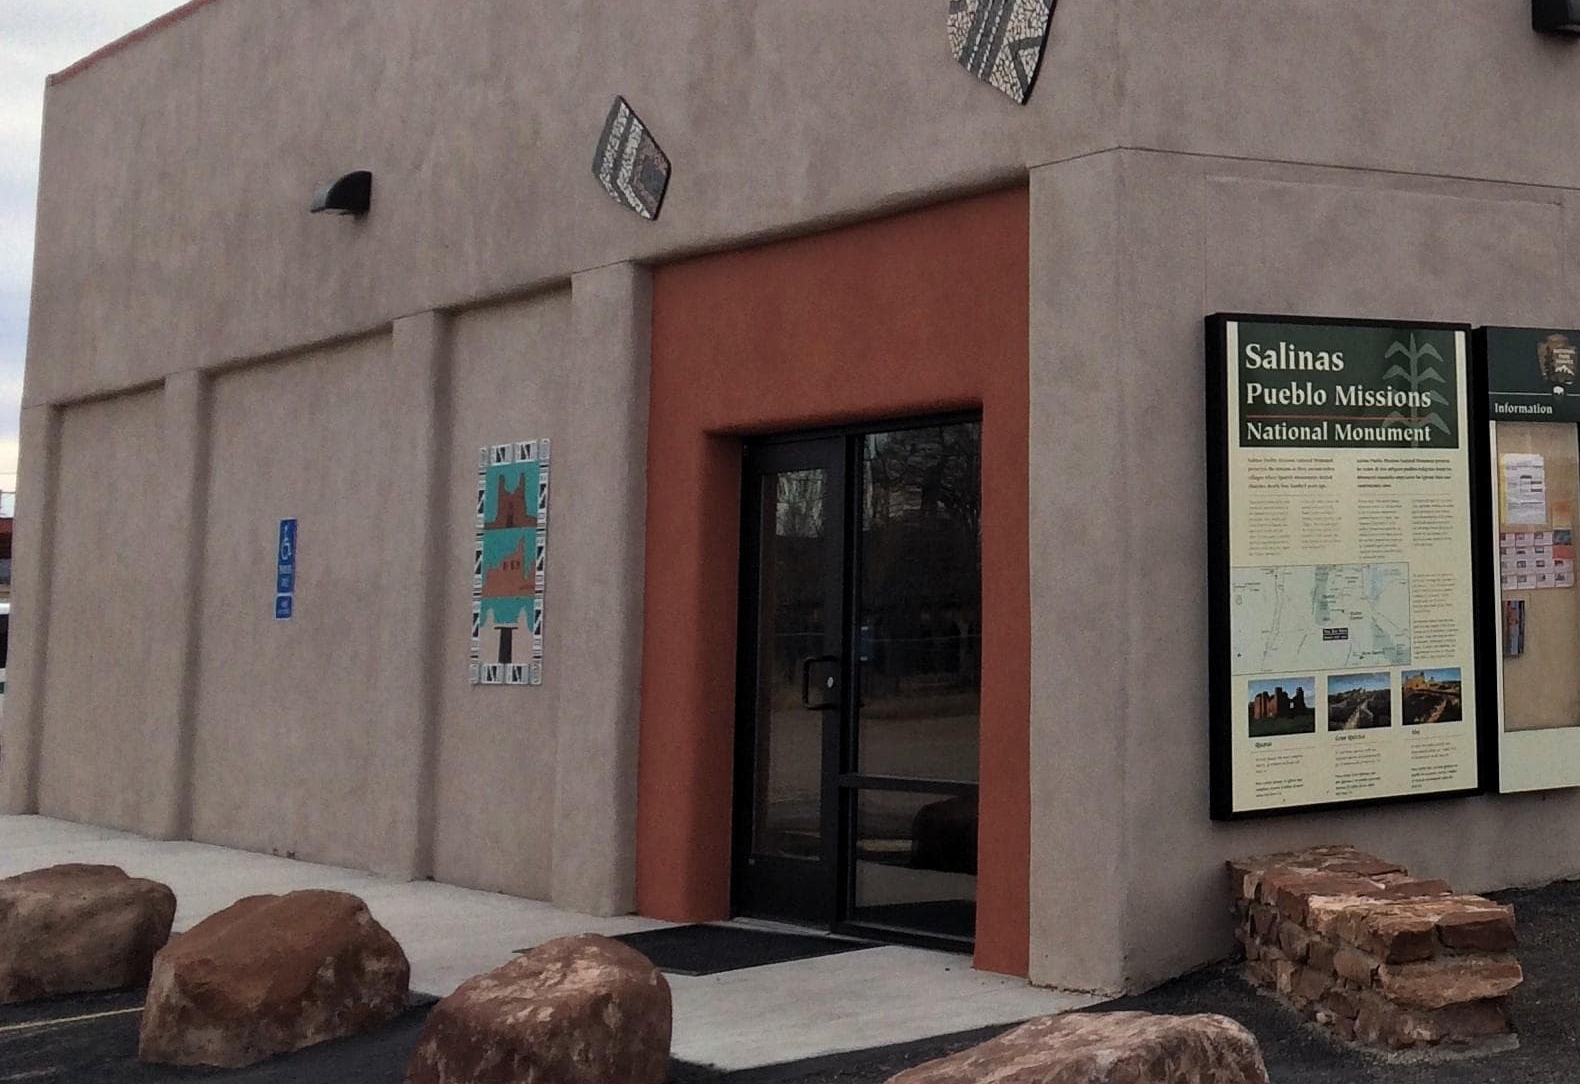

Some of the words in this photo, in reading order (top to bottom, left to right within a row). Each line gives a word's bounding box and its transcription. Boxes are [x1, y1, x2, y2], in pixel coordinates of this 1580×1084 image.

[1245, 341, 1344, 372] Salinas
[1246, 381, 1327, 406] Pueblo
[1335, 384, 1432, 408] Missions
[1494, 403, 1553, 414] Information
[1246, 421, 1328, 441] National
[1335, 423, 1431, 442] Monument
